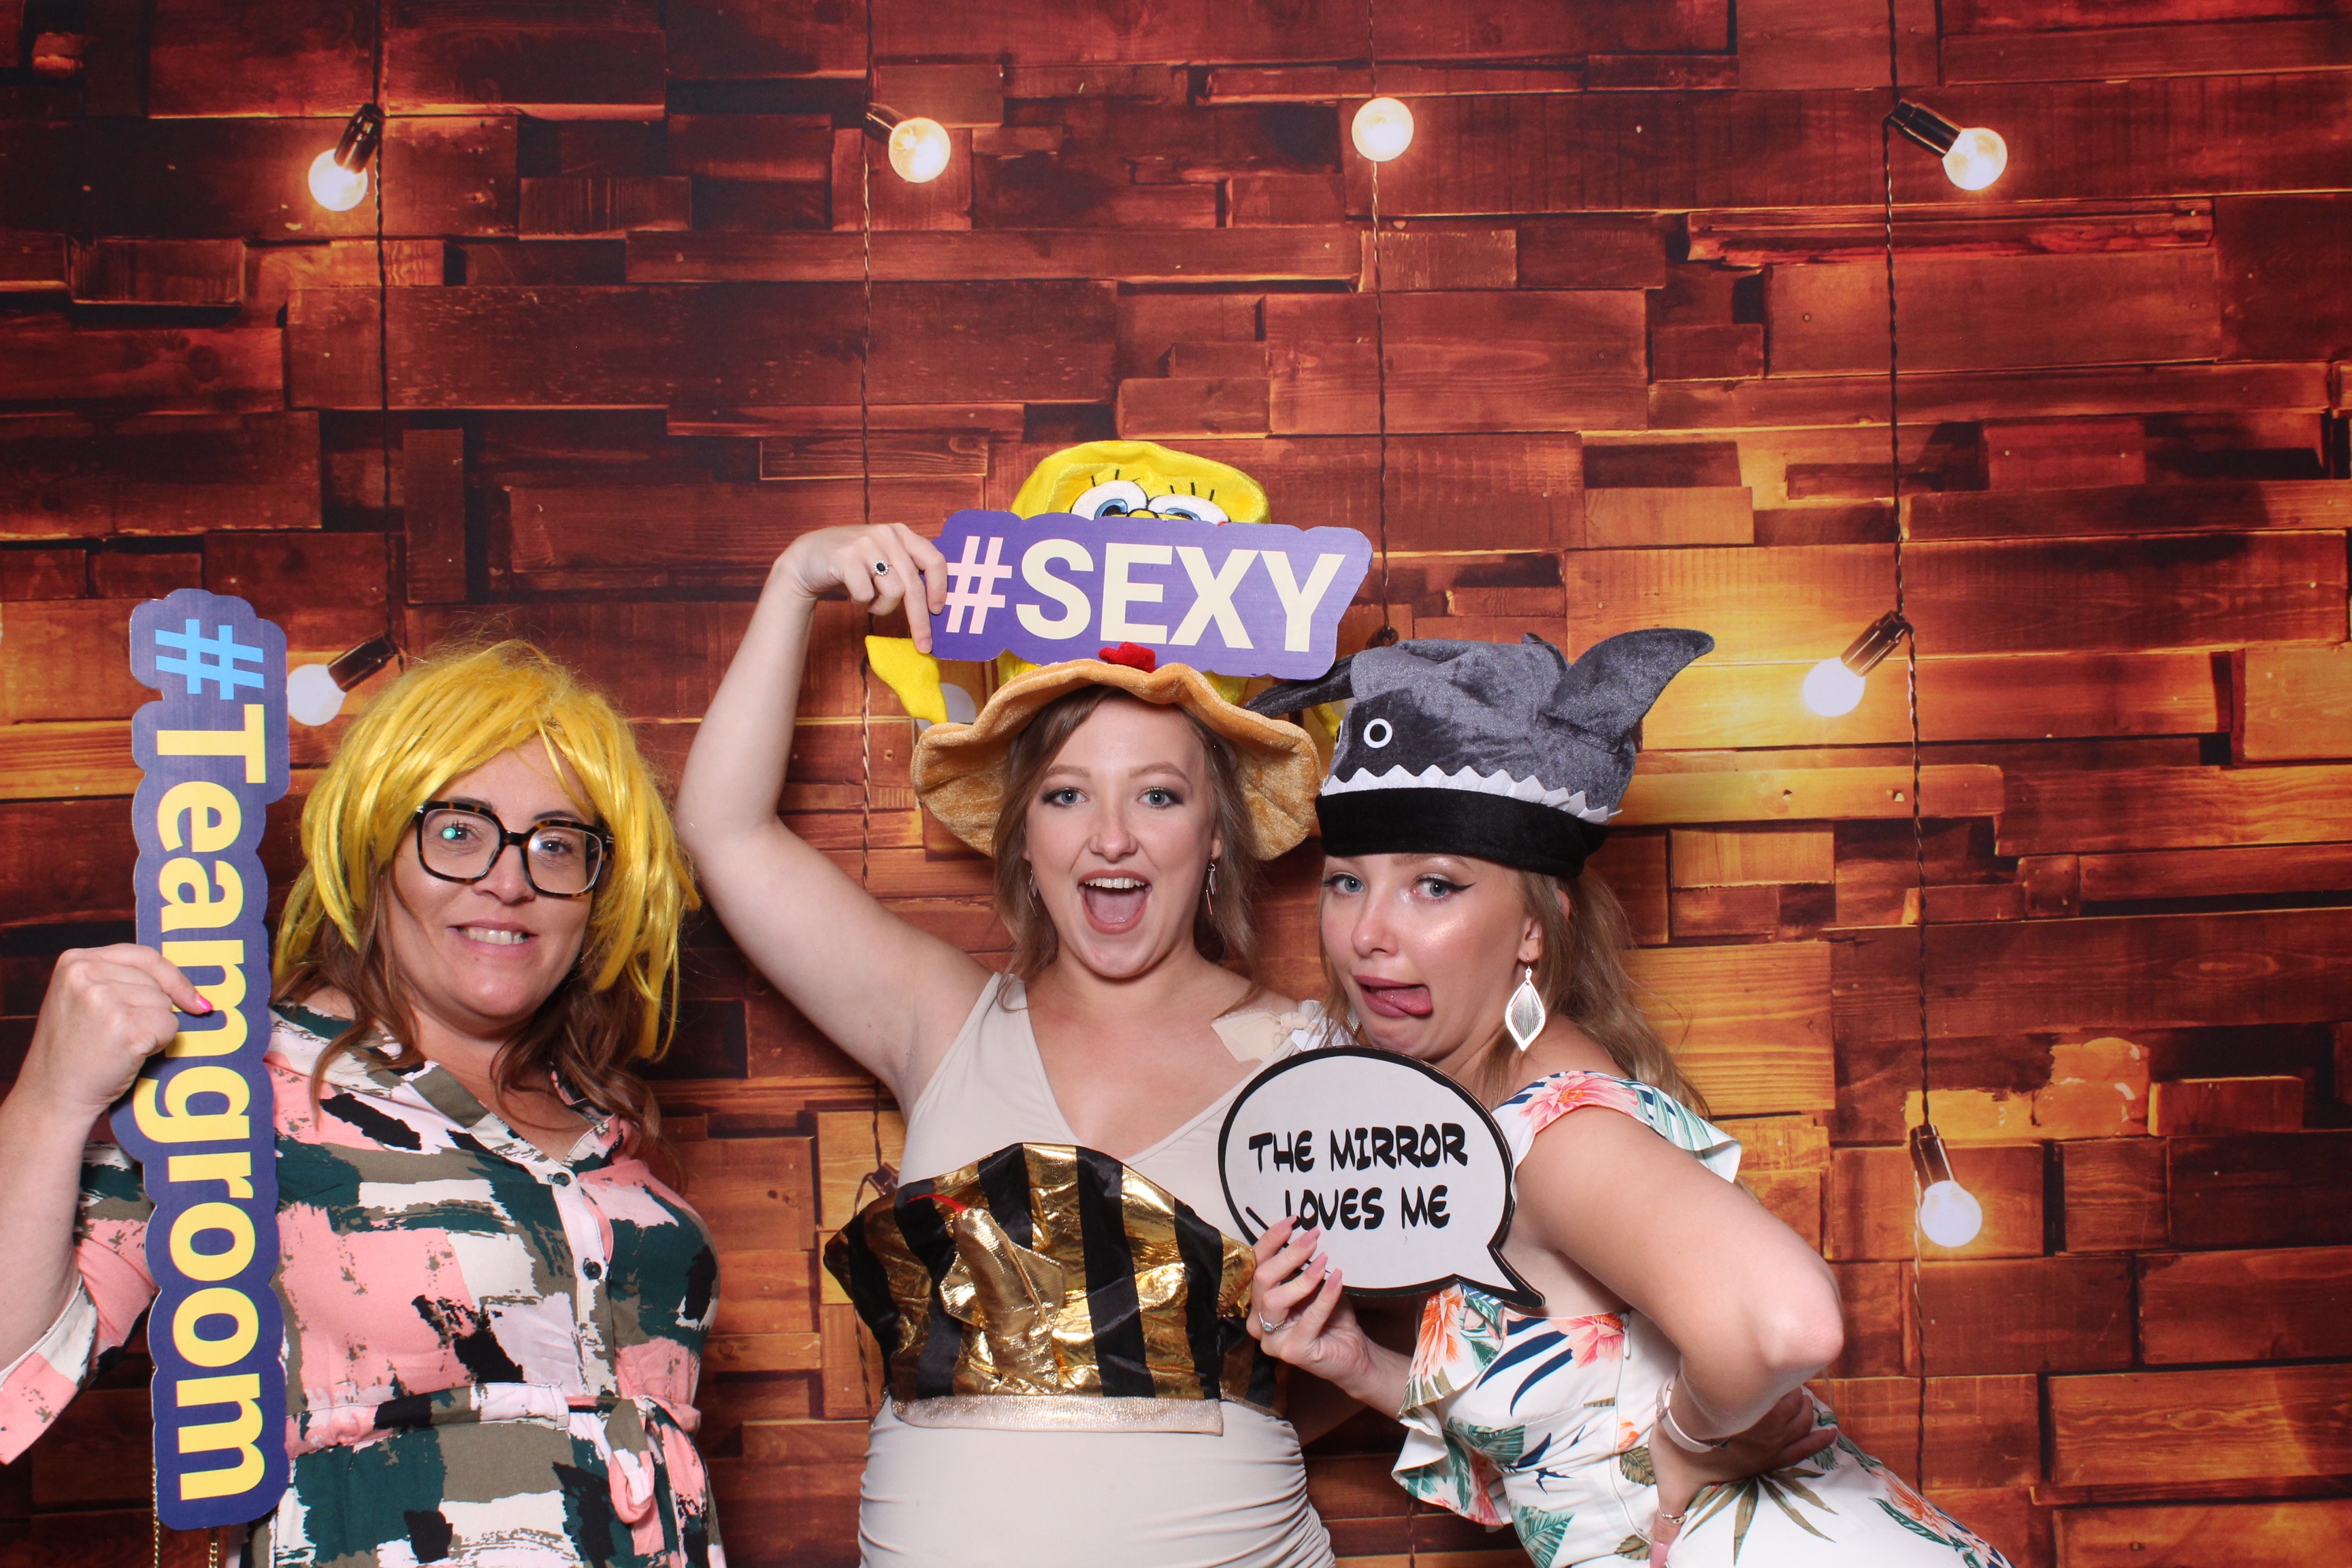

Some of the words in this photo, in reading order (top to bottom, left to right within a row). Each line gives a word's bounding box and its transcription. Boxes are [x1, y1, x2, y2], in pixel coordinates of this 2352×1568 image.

[945, 536, 1346, 653] #SEXY
[133, 618, 267, 1501] #Teamgroom
[1248, 1130, 1315, 1174] THE
[1330, 1122, 1468, 1171] MIRROR
[1284, 1186, 1385, 1230] LOVES
[1401, 1184, 1451, 1229] ME
